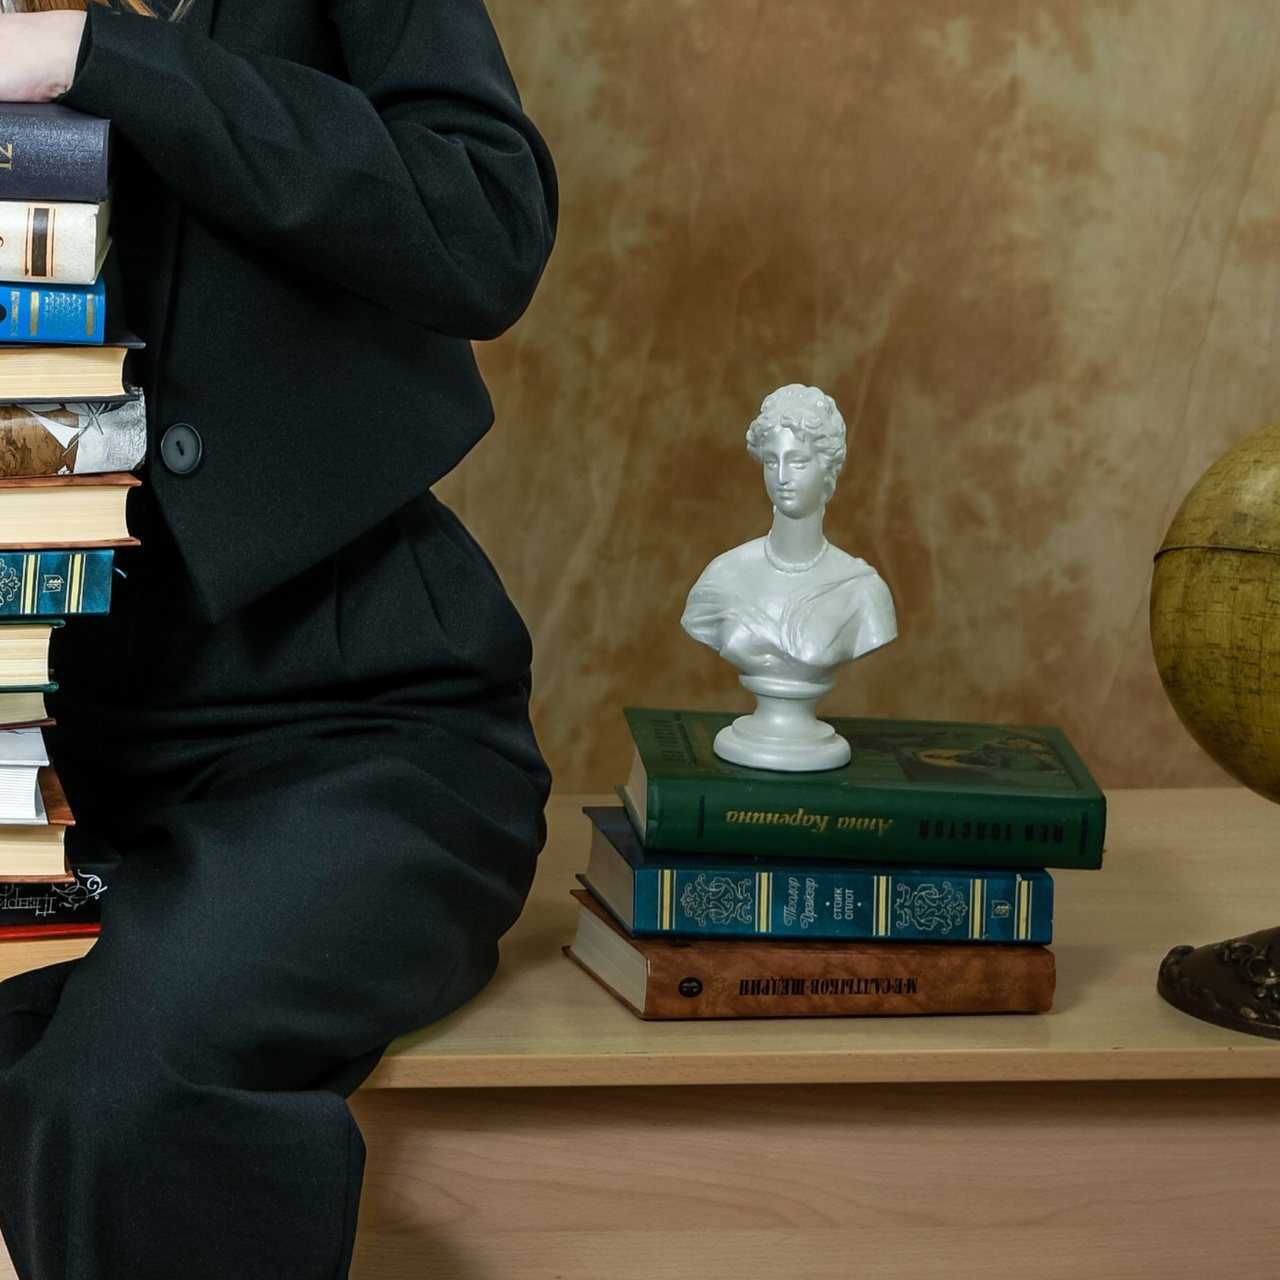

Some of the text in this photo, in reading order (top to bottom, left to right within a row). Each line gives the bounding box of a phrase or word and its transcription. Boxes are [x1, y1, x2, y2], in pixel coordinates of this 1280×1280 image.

[724, 807, 893, 837] Анна Каренина
[833, 887, 843, 920] СТОИК
[844, 888, 854, 920] ОПЛОТ
